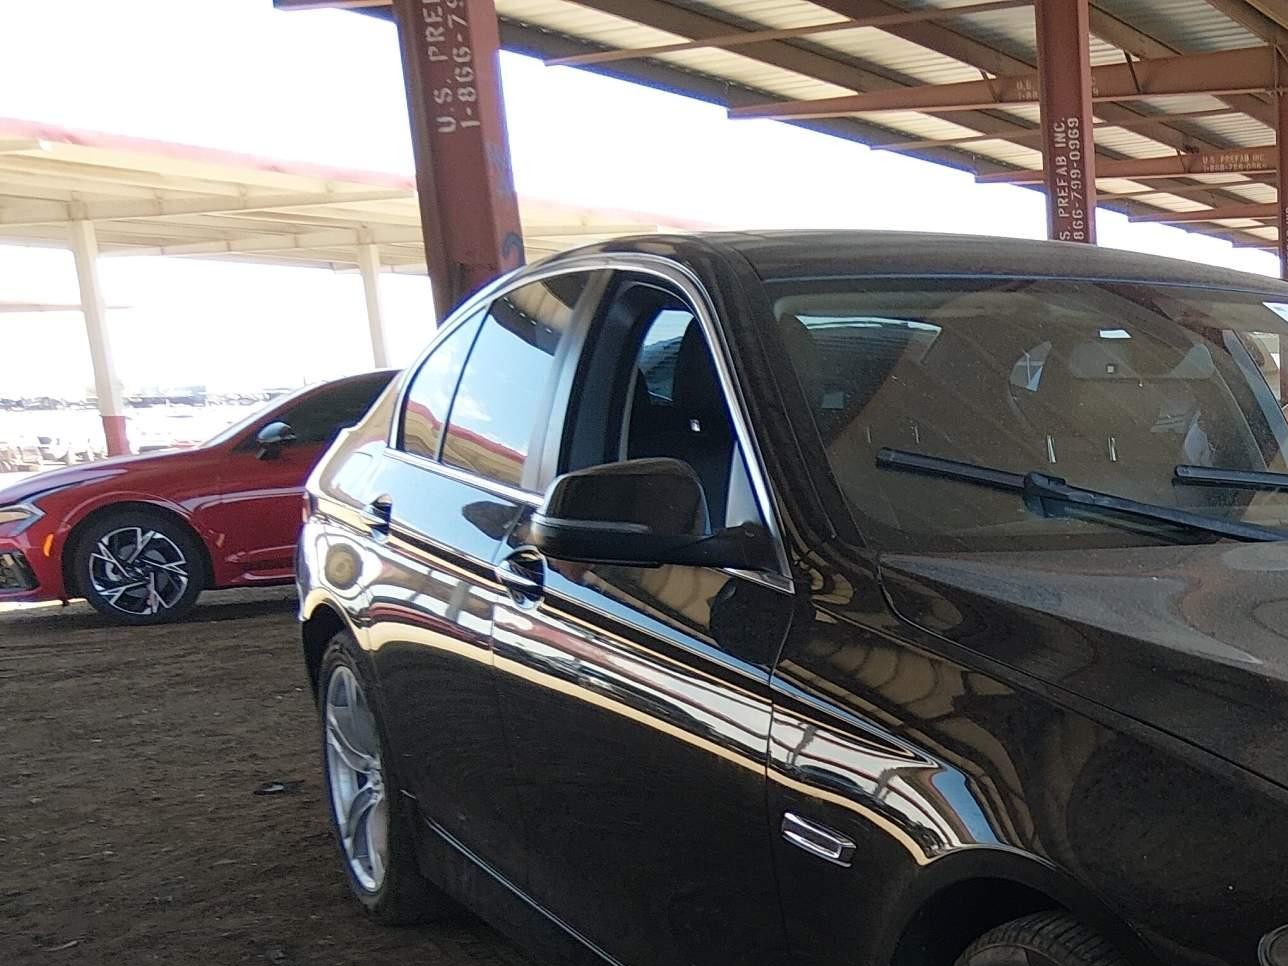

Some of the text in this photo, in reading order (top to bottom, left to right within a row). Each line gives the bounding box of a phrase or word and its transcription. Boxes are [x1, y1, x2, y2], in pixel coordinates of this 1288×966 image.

[422, 0, 457, 133] U.S. PRE
[1053, 117, 1067, 147] INC.
[1055, 156, 1070, 217] PREFAB
